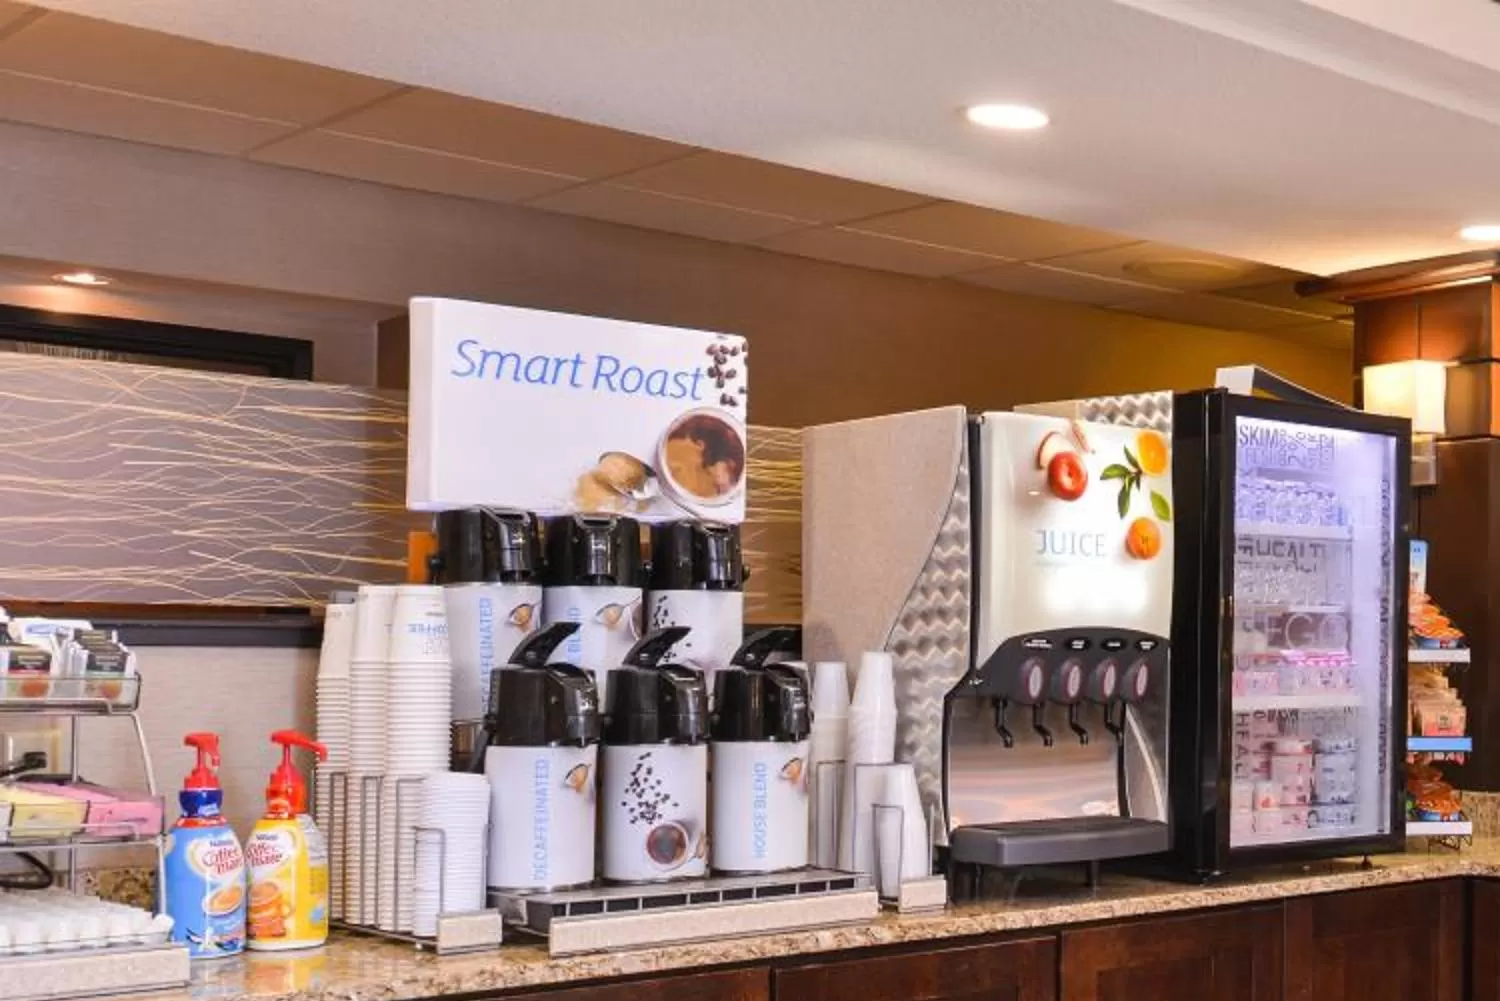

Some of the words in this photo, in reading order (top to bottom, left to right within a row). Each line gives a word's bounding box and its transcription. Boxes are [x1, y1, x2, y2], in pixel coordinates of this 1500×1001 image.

[451, 338, 586, 388] Smart
[592, 354, 705, 401] Roast
[1034, 528, 1108, 558] JUICE
[753, 761, 768, 810] BLEND
[532, 758, 550, 881] DECAFFEINATED
[753, 813, 768, 859] HOUSE
